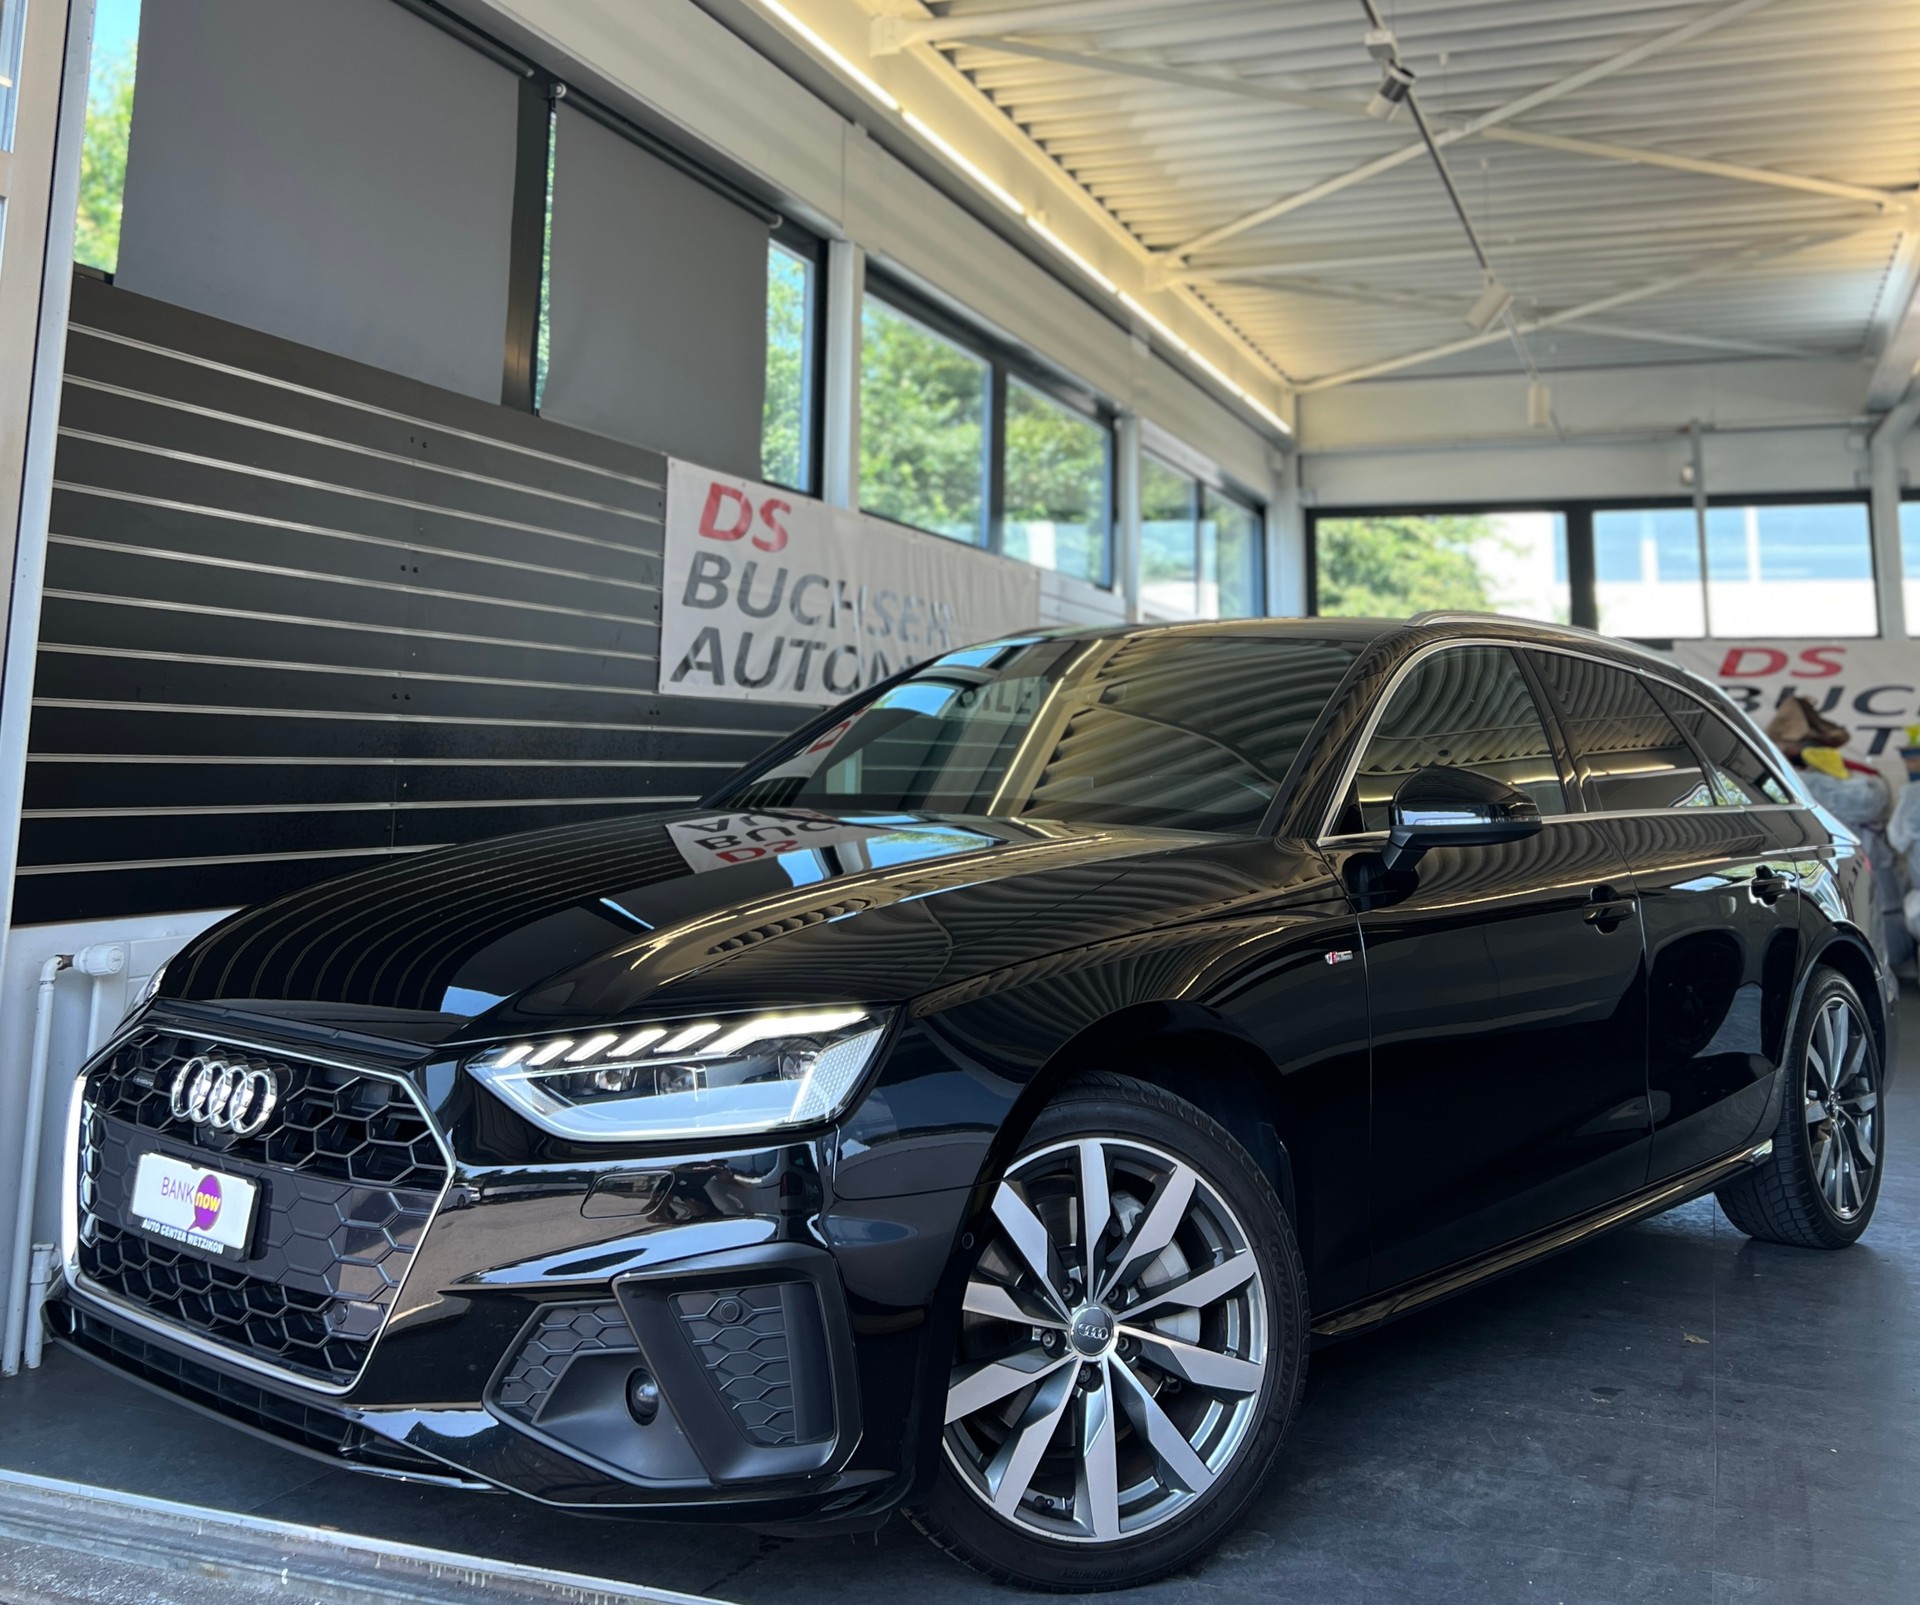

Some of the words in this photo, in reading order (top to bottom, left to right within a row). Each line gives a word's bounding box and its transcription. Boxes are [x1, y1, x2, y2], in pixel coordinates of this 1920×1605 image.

[699, 482, 791, 552] DS
[682, 551, 953, 649] BUCHSER
[1718, 646, 1847, 678] DS
[1719, 685, 1920, 717] BUC
[161, 1176, 195, 1205] BANK
[195, 1191, 220, 1212] now
[141, 1218, 161, 1234] AUTO
[160, 1224, 187, 1242] CENTER
